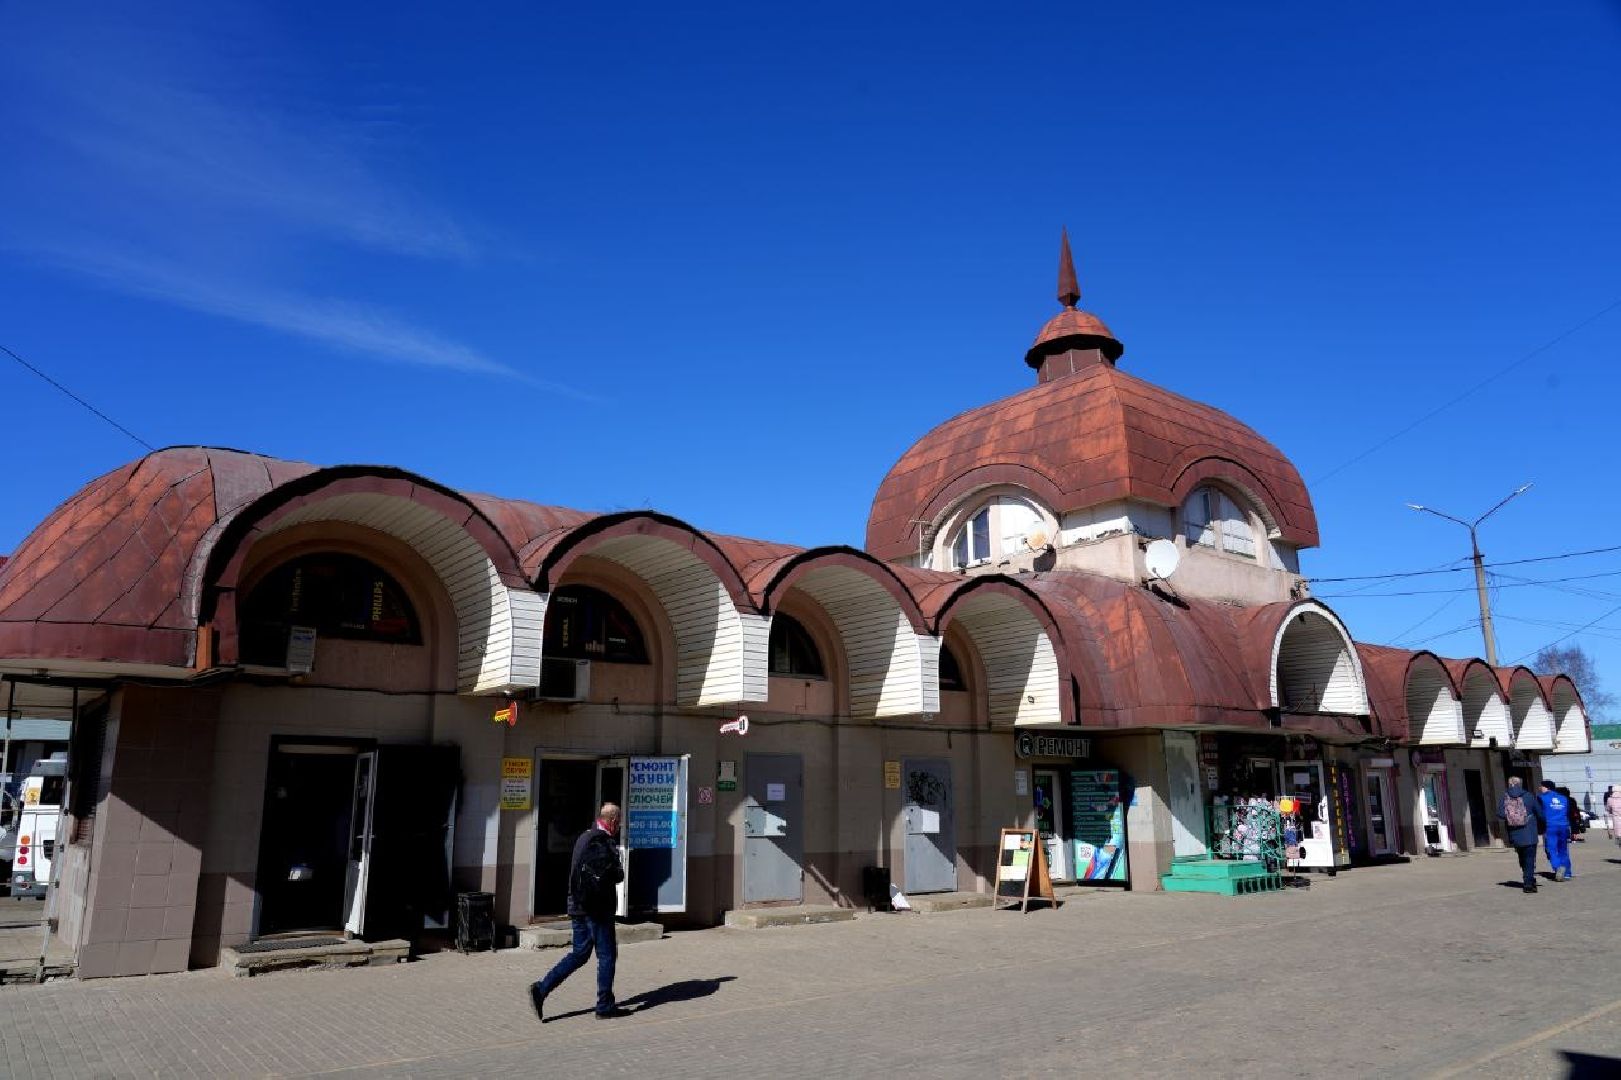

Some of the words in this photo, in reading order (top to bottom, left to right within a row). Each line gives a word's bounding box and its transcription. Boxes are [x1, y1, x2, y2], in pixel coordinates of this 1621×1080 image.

[372, 581, 384, 621] PHILIPS
[1037, 736, 1091, 758] РЕМОНТ
[631, 762, 675, 772] ЕМОНТ
